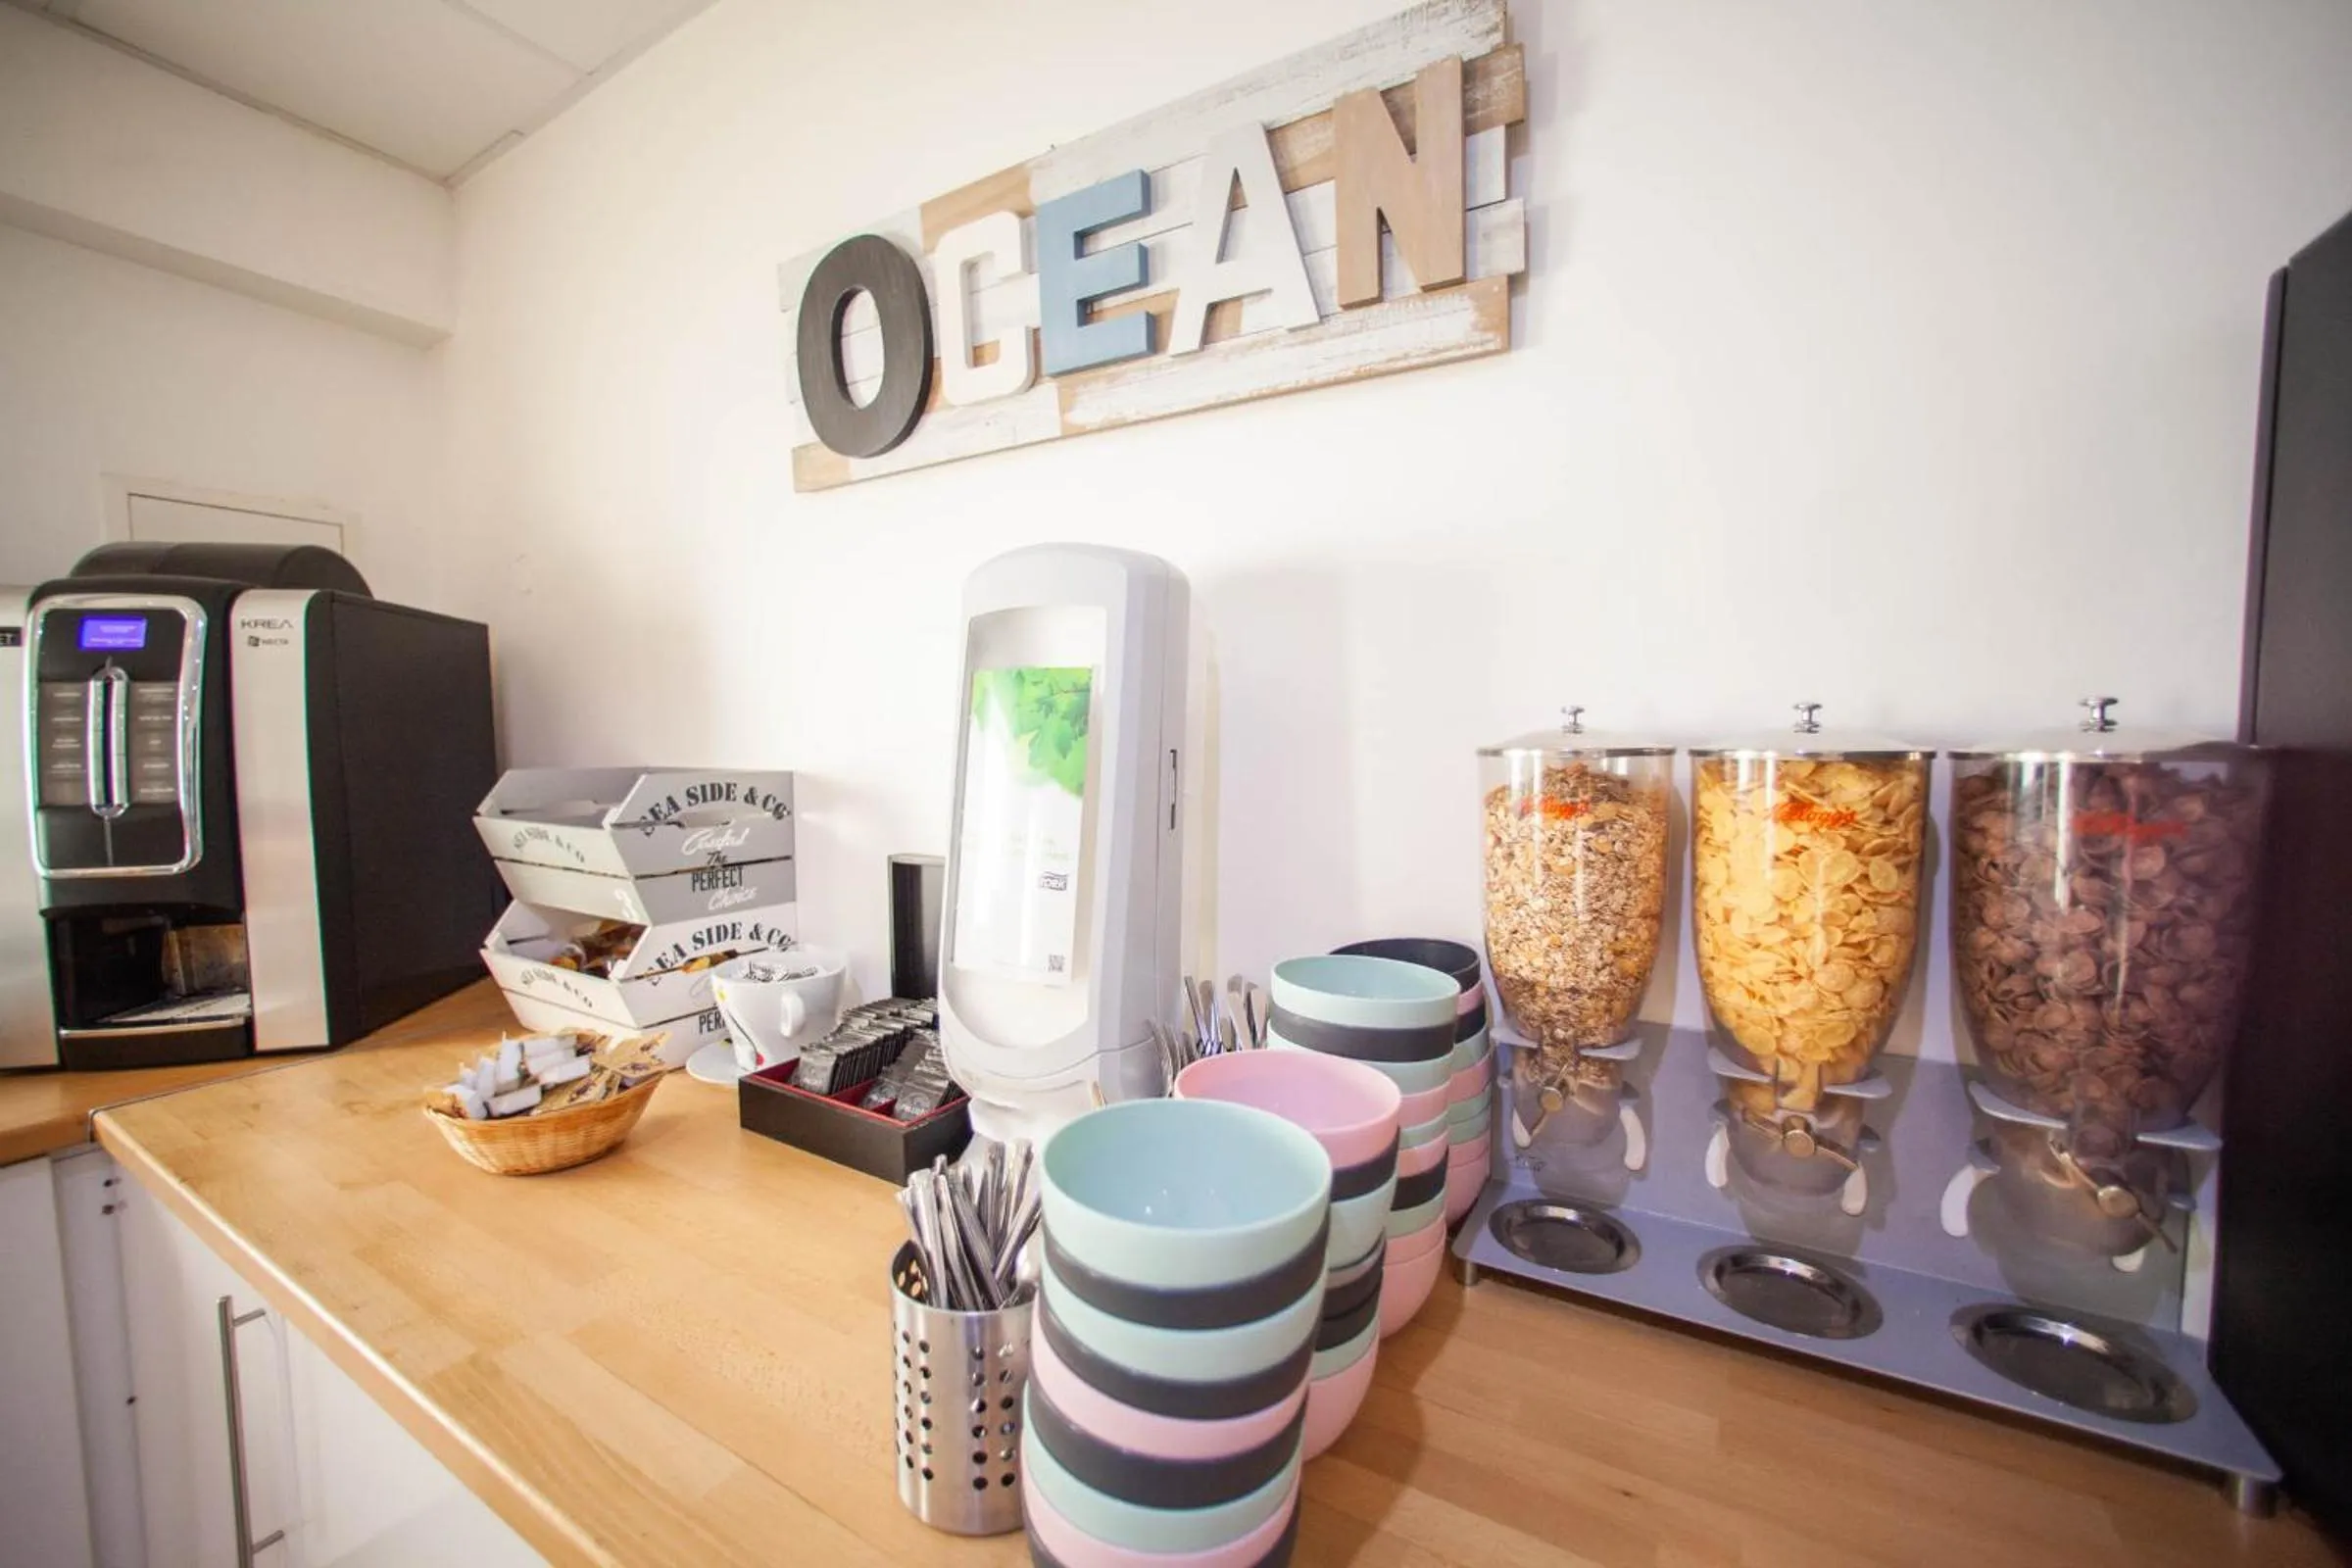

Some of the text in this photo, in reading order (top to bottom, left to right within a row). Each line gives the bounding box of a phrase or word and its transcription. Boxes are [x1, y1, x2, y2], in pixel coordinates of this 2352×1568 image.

[797, 55, 1465, 459] OCEAN
[241, 618, 294, 629] KREA
[639, 795, 682, 837] SEA
[686, 782, 738, 808] SIDE
[744, 786, 759, 807] &
[692, 865, 745, 893] PERFECT
[692, 921, 743, 951] SIDE
[749, 922, 762, 942] &
